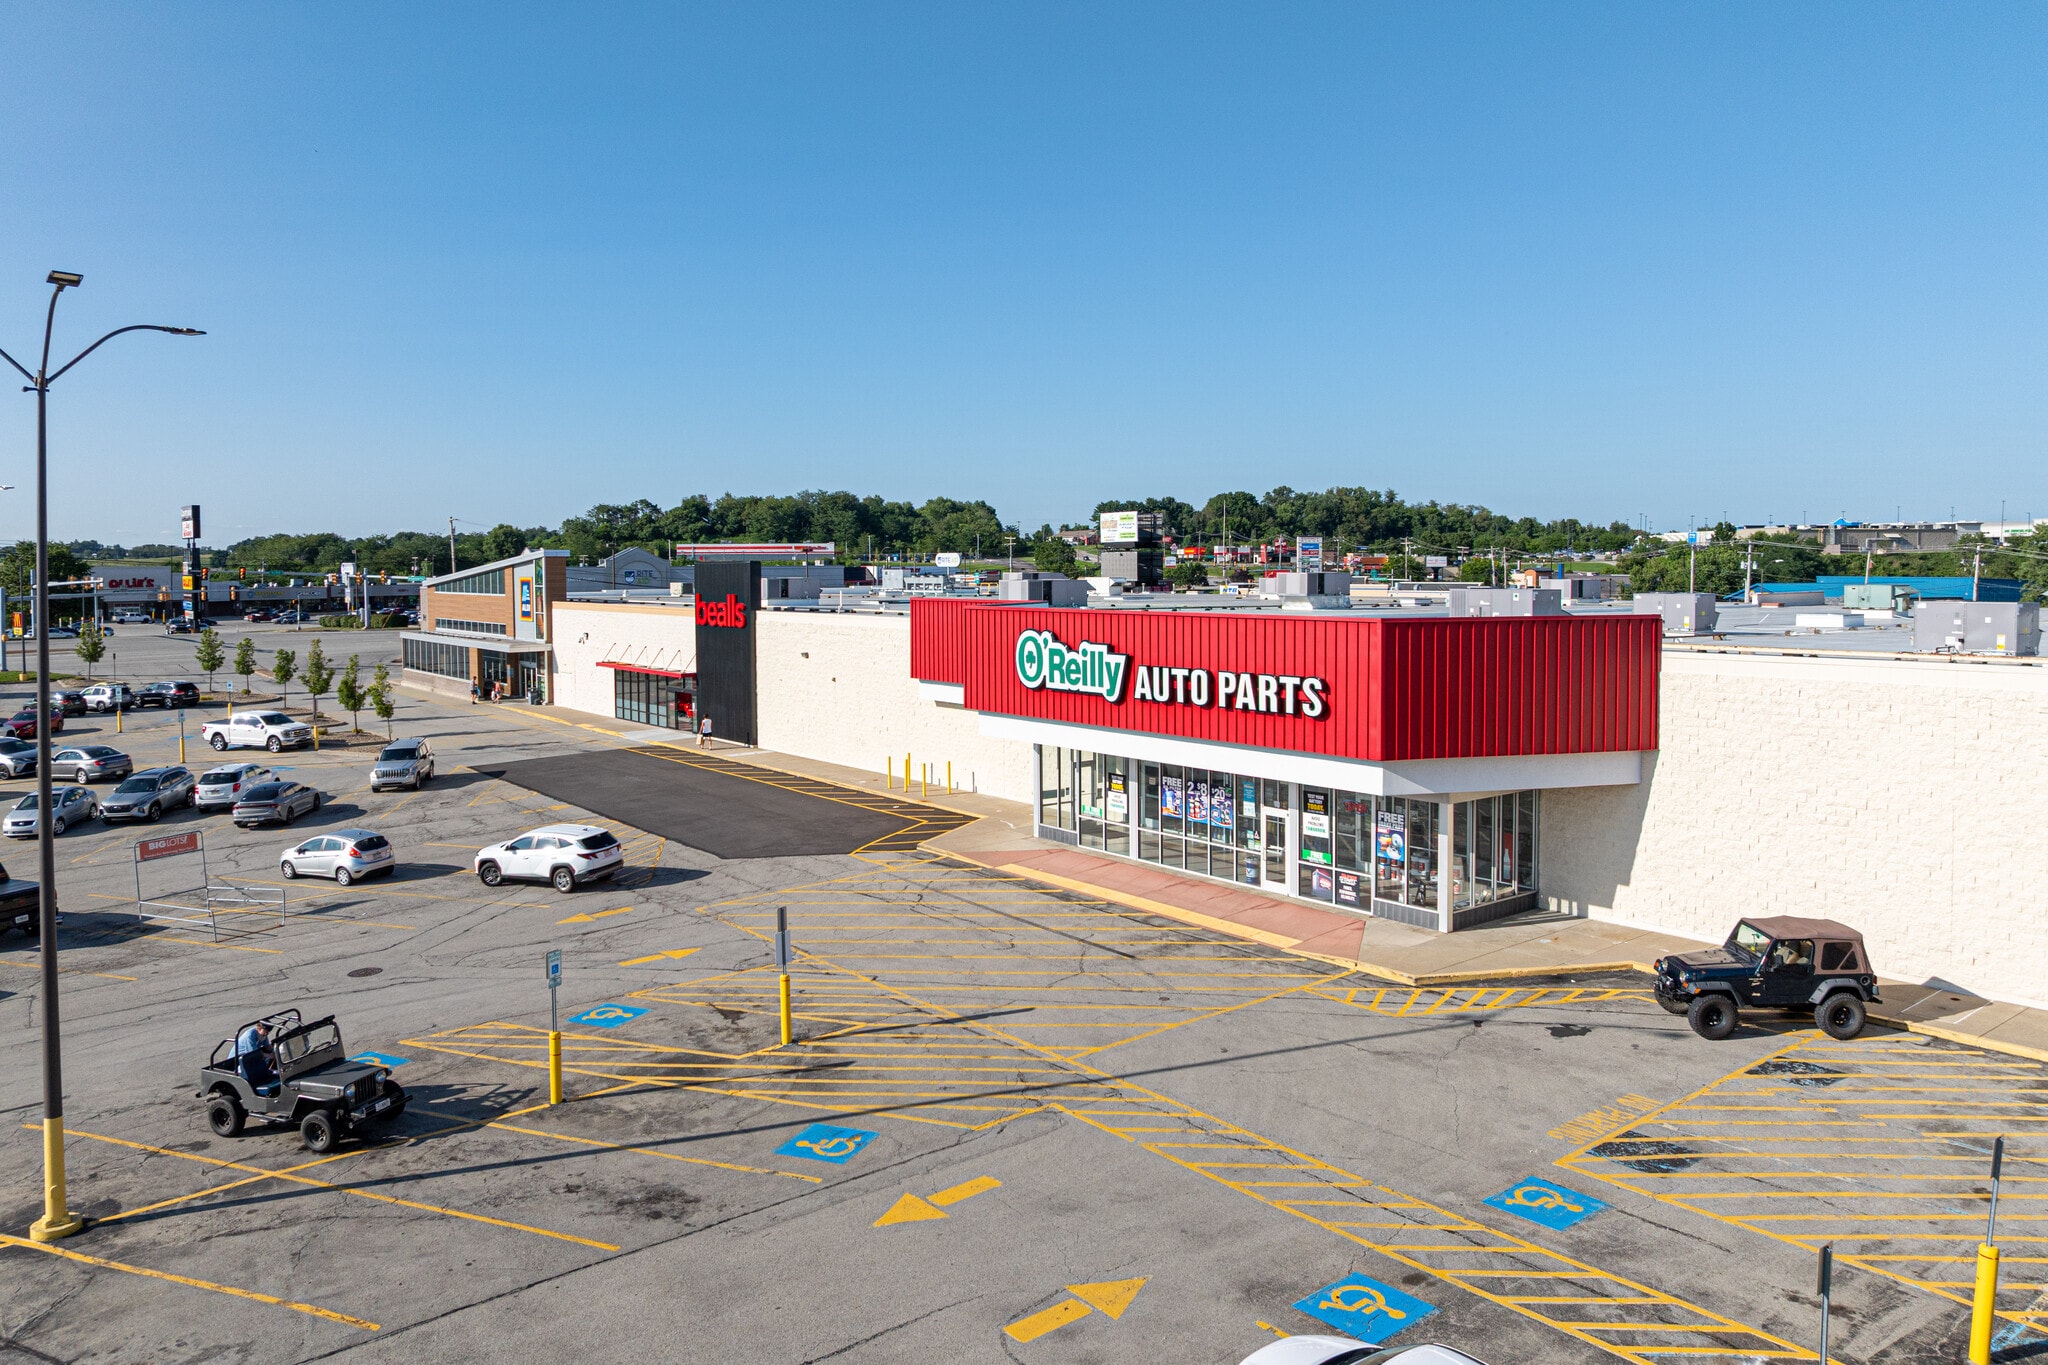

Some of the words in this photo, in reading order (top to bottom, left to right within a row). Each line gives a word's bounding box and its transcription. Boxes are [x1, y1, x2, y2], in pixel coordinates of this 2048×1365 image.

[636, 569, 653, 578] RITE
[695, 592, 747, 628] bealls
[1018, 635, 1121, 697] O'Reilly
[1134, 665, 1209, 706] AUTO
[1218, 671, 1324, 717] PARTS
[1162, 776, 1182, 788] FREE
[1378, 811, 1404, 824] FREE
[148, 842, 166, 850] BIG
[167, 836, 187, 847] LOTS!
[1547, 1105, 1636, 1145] PARKING
